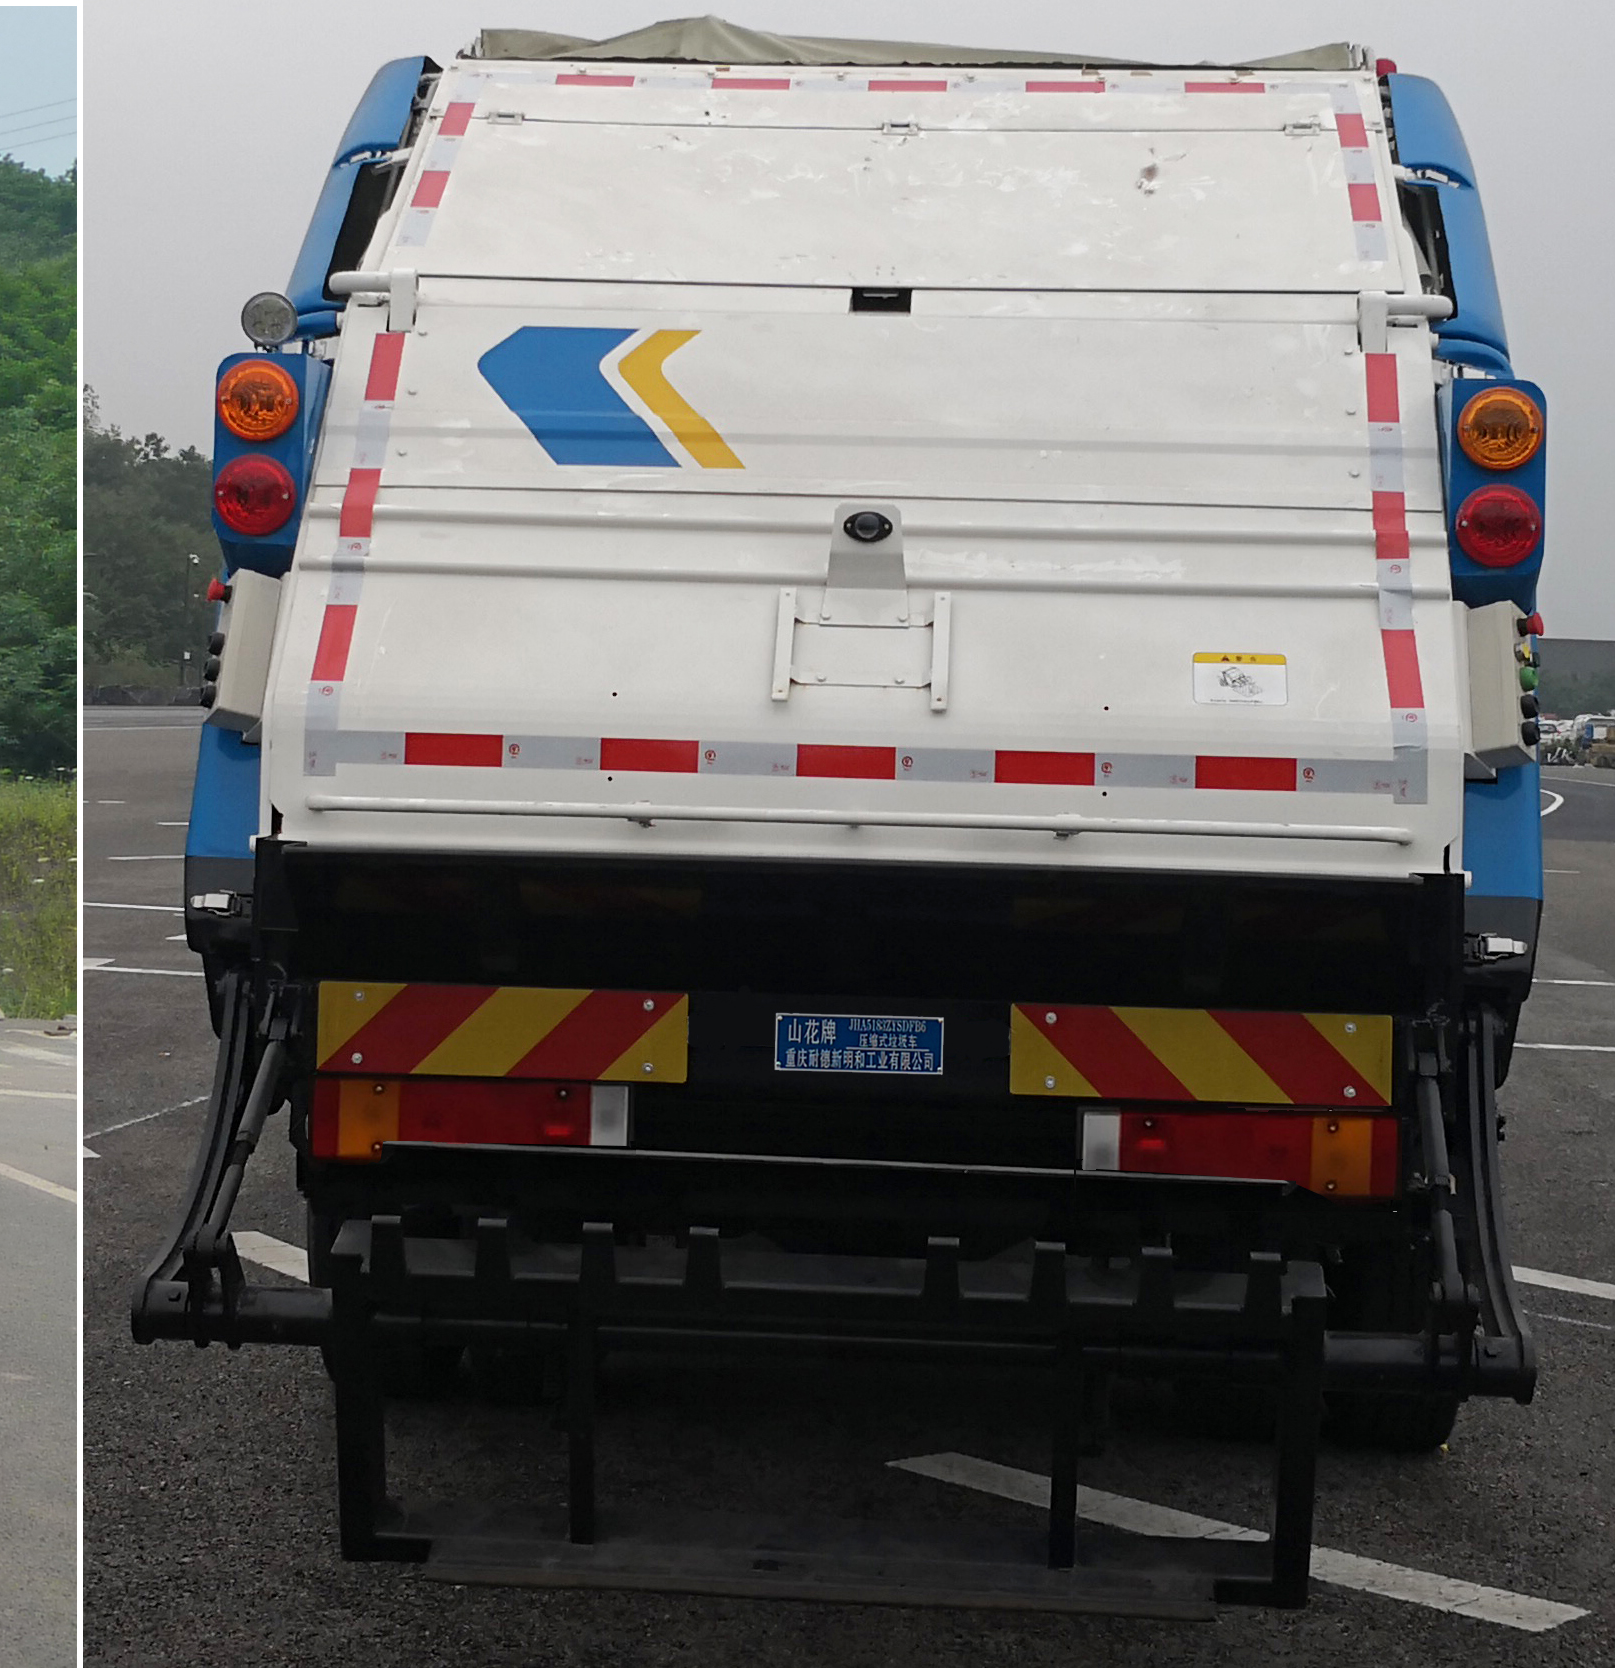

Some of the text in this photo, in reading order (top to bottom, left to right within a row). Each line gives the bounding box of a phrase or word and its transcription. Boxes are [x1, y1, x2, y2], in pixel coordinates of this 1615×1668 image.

[788, 1018, 836, 1045] 山花牌
[859, 1033, 918, 1049] 压缩式垃圾车
[785, 1047, 934, 1072] 重庆耐德新明和工业有限公司
